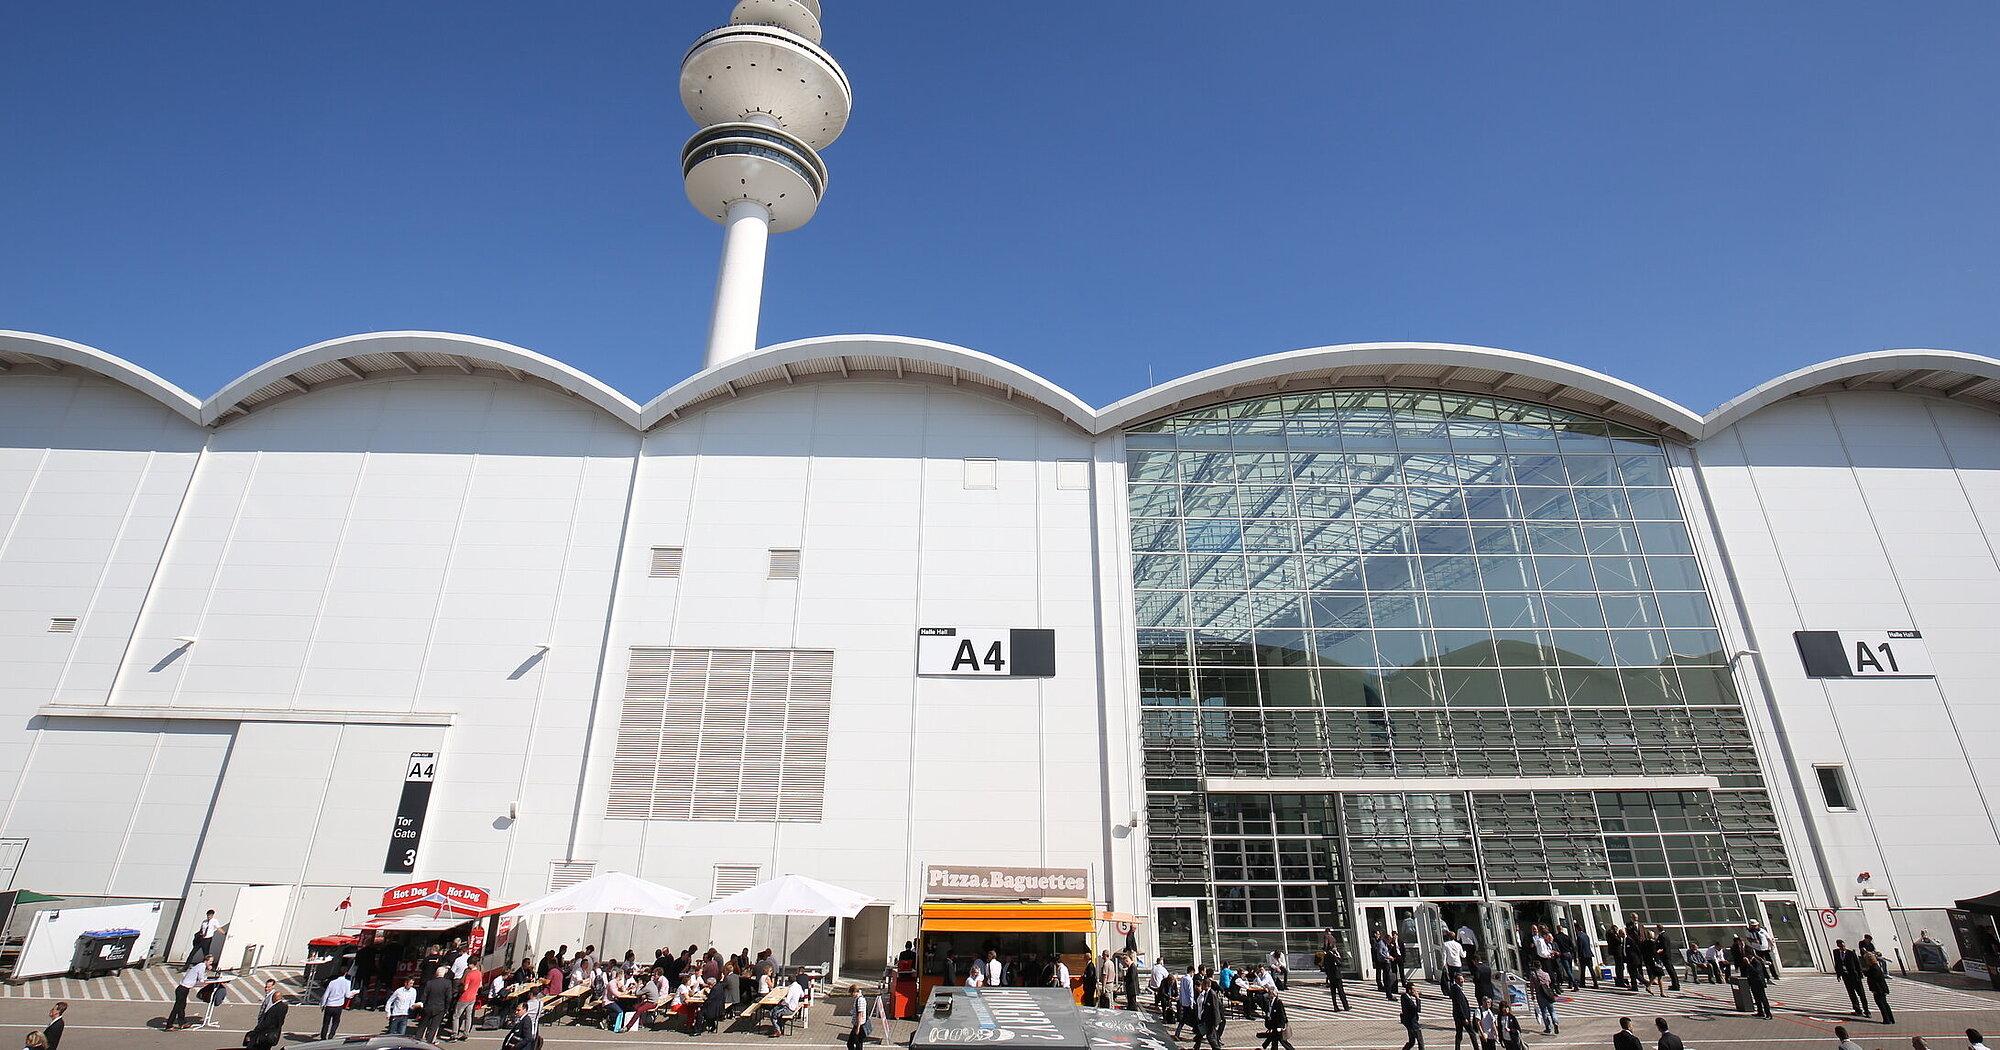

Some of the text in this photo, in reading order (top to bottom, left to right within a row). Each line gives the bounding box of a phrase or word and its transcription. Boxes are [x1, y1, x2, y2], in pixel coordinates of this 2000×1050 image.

[951, 639, 1005, 671] A4
[1857, 642, 1899, 672] A1
[408, 762, 434, 779] A4
[397, 816, 413, 826] Tor
[393, 828, 417, 839] Gate
[403, 849, 416, 866] 3
[928, 869, 1085, 892] Pizza & Baguettes
[393, 887, 428, 899] Hot Dog
[446, 886, 480, 902] Hot Dog
[1122, 921, 1128, 931] 5
[1826, 914, 1833, 923] 5
[979, 989, 1065, 1040] HUNGRY?
